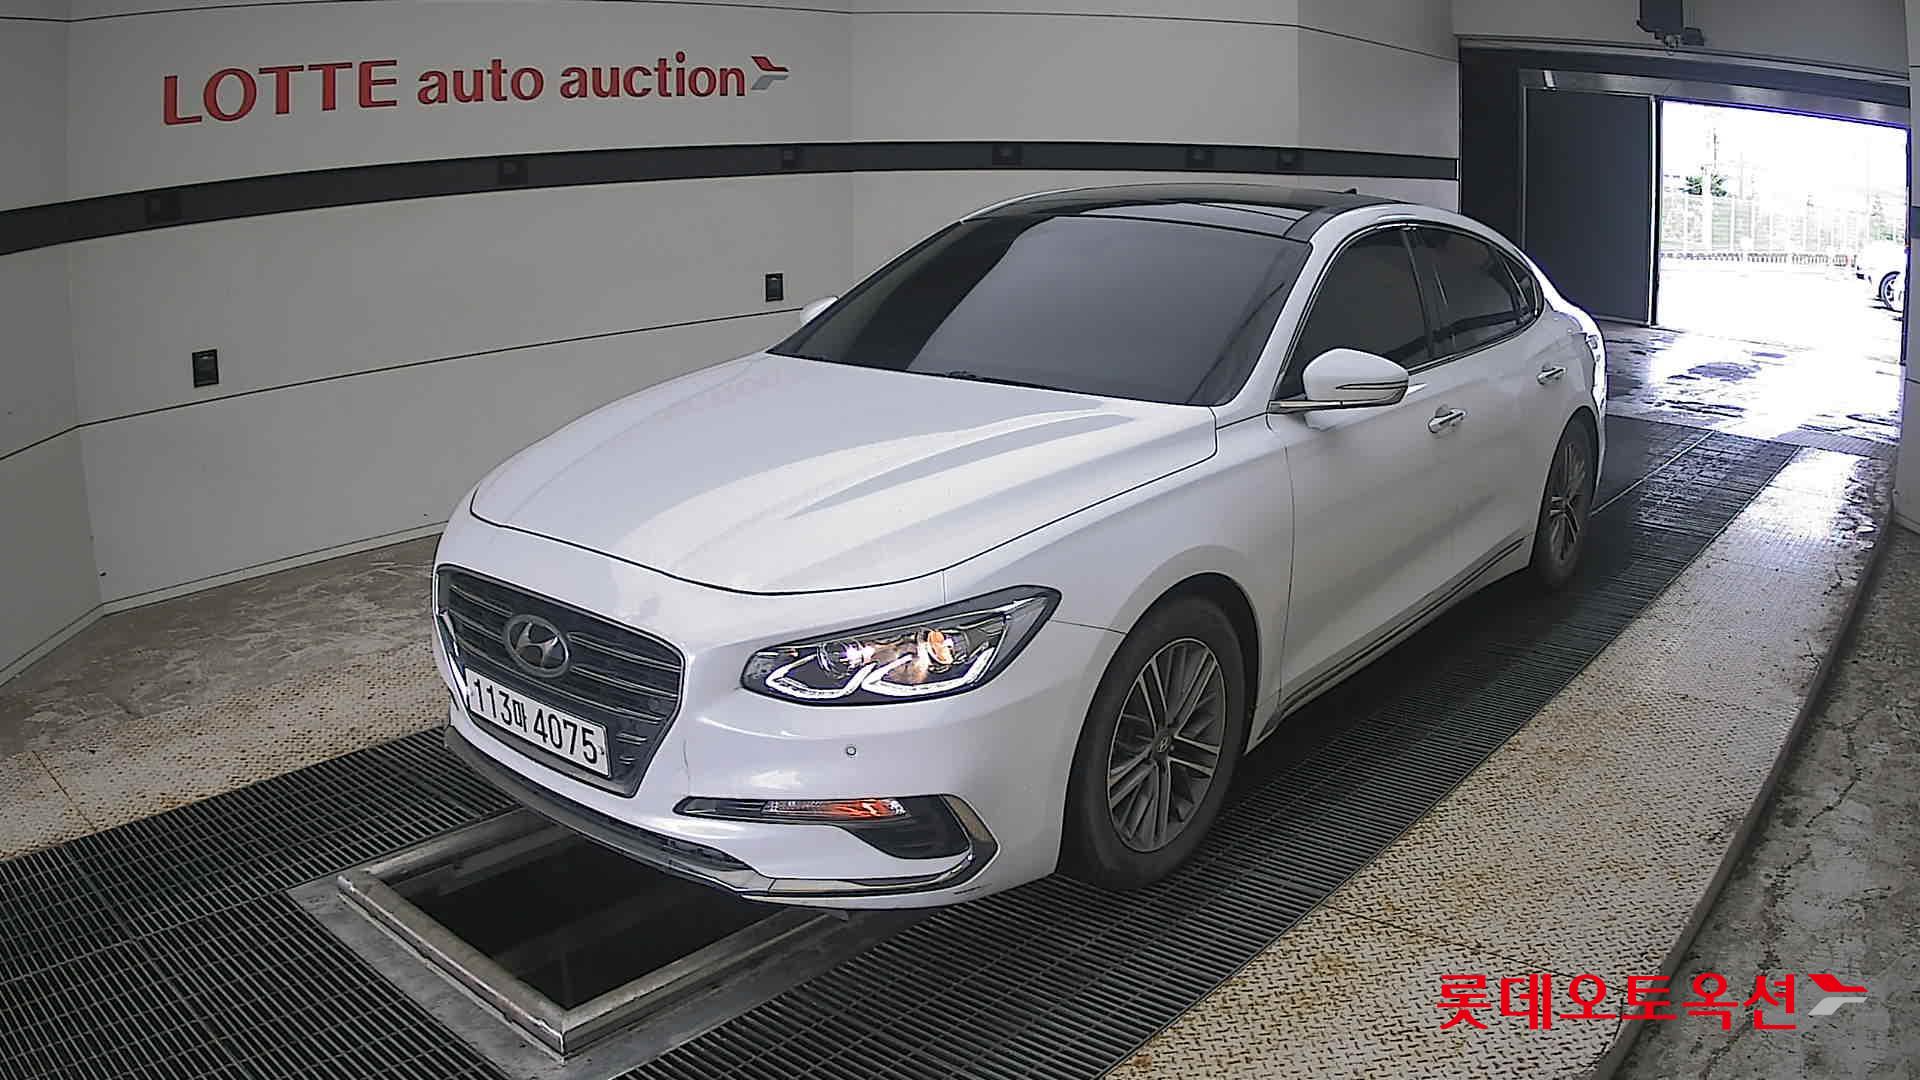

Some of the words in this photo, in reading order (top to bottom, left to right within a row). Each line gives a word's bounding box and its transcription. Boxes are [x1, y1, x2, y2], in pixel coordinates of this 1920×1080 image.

[163, 61, 399, 125] LOTTE
[417, 60, 545, 105] auto
[561, 52, 746, 98] auction
[533, 707, 598, 764] 4075
